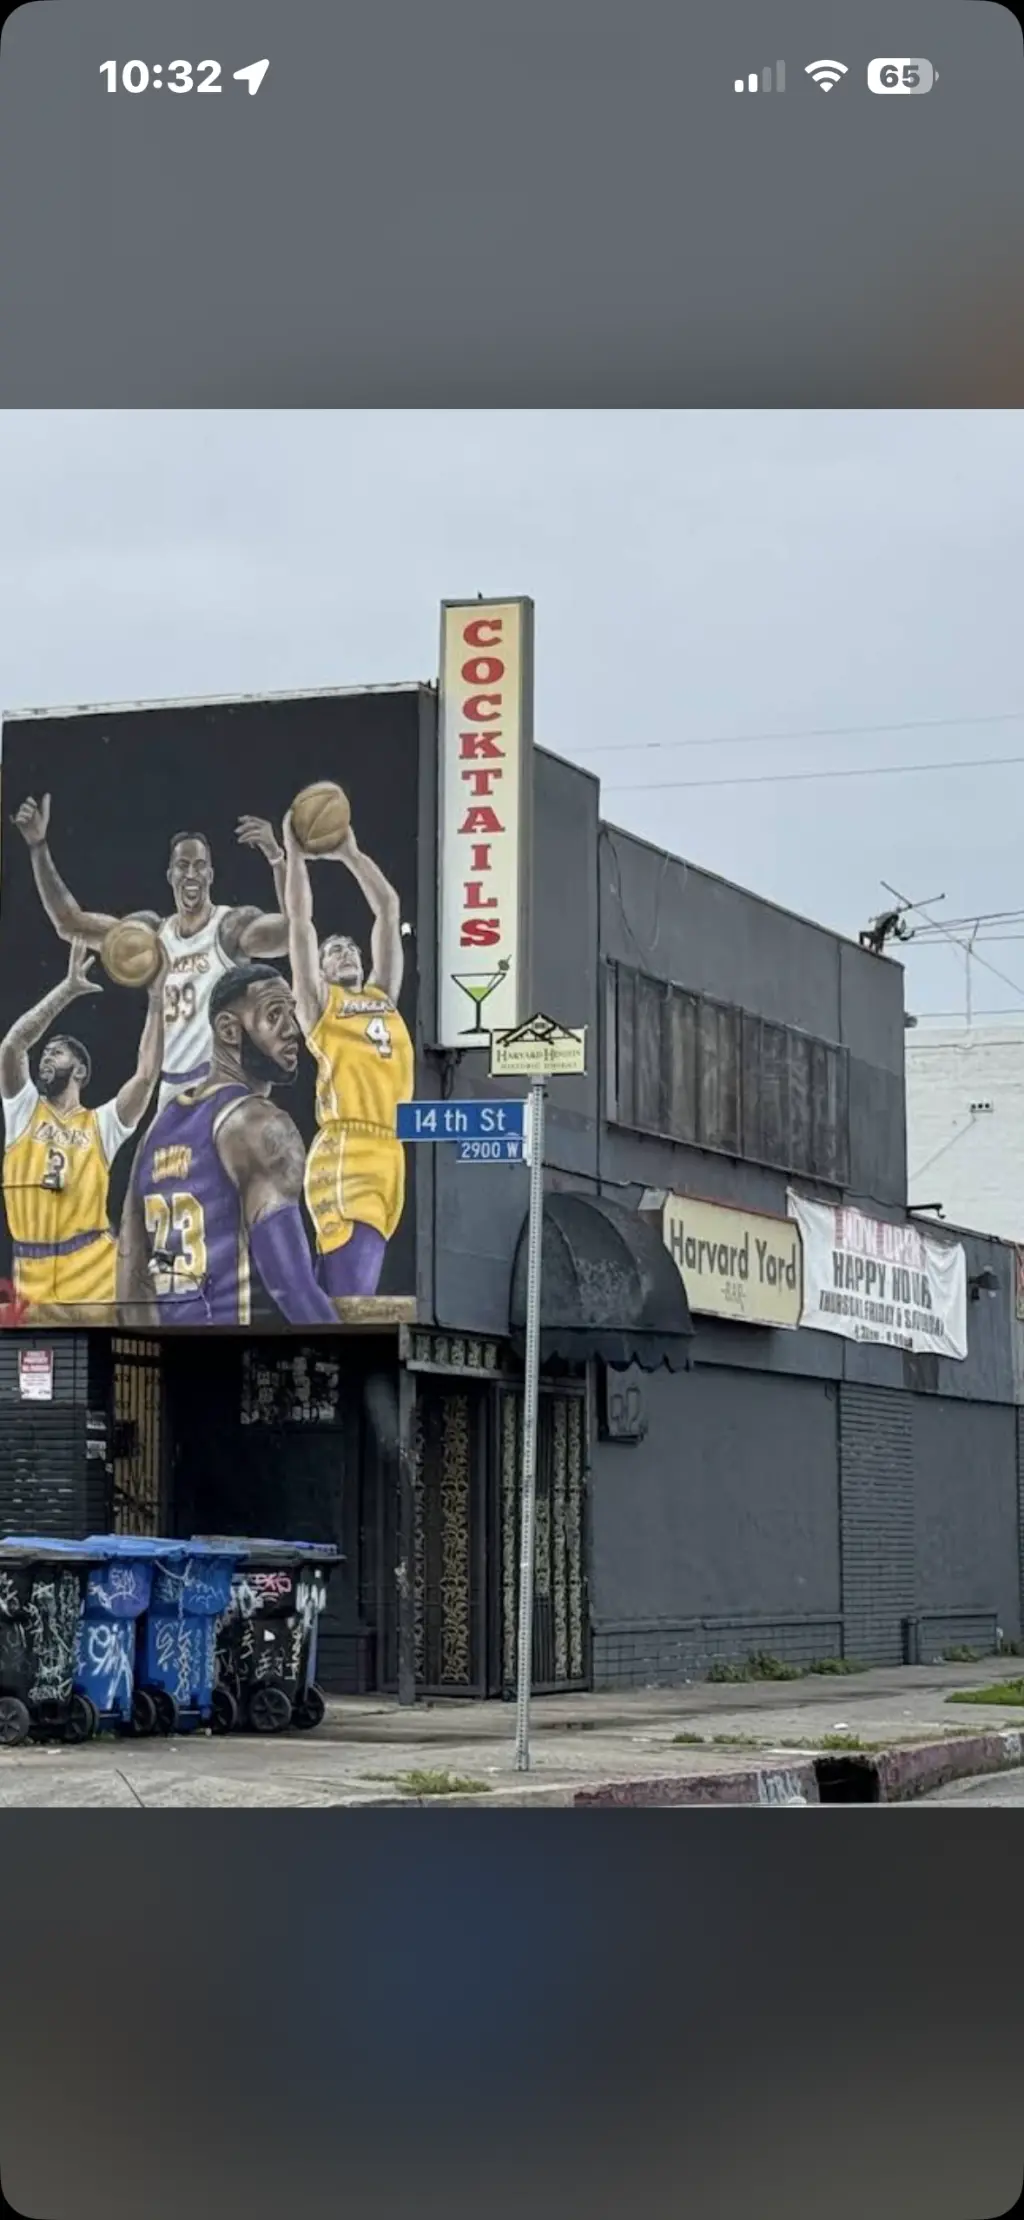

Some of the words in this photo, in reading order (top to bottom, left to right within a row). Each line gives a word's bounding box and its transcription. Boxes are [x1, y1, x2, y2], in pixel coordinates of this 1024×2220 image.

[457, 618, 506, 947] COCKTAILS
[364, 1015, 393, 1059] 4
[480, 1107, 506, 1132] St
[461, 1141, 501, 1159] 2900
[506, 1141, 520, 1158] W
[144, 1192, 208, 1295] 23
[670, 1217, 749, 1280] Harvard
[755, 1237, 797, 1290] Yard
[832, 1251, 887, 1298] HAPPY
